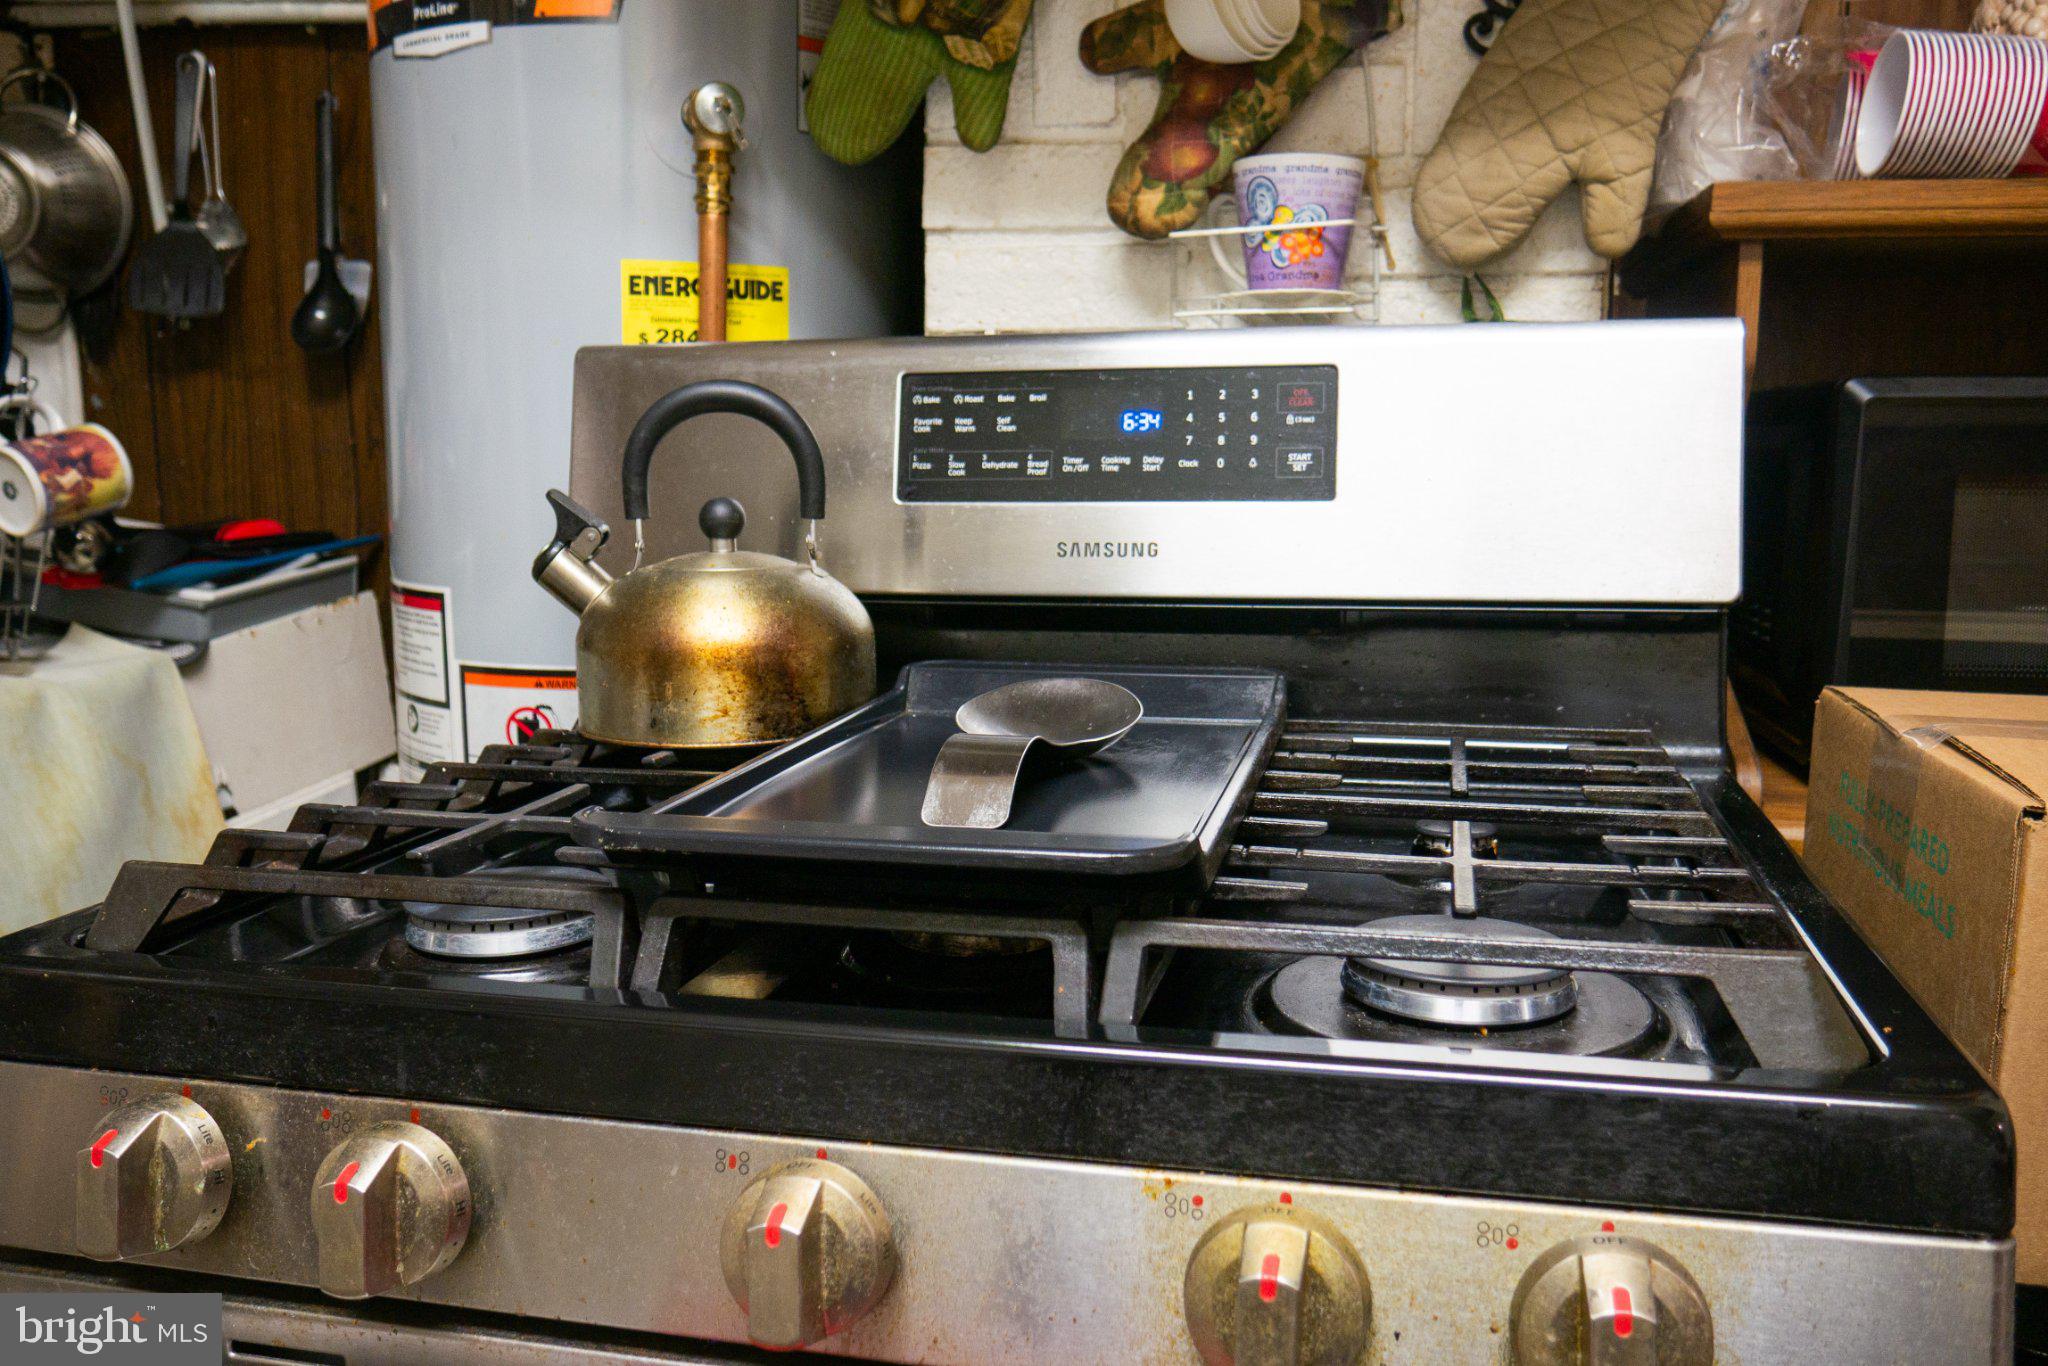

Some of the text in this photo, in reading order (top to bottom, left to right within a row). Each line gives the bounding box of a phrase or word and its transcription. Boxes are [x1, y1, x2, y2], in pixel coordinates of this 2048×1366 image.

[964, 394, 984, 404] Roast
[997, 394, 1016, 403] Bake
[1029, 393, 1047, 403] Broil
[1187, 390, 1194, 400] 1
[1218, 389, 1226, 400] 2
[1251, 388, 1259, 400] 3
[914, 417, 943, 426] Favorite
[955, 417, 973, 426] Keep
[997, 416, 1012, 425] Self
[1122, 412, 1162, 431] 6:34
[1186, 412, 1193, 423] 4
[1218, 412, 1226, 423] 5
[1250, 412, 1259, 423] 6
[913, 425, 931, 433] Cook
[955, 425, 976, 433] Warm
[997, 424, 1017, 432] Clean
[1186, 435, 1193, 446] 7
[1217, 435, 1225, 446] 8
[1250, 435, 1258, 446] 9
[1062, 456, 1084, 464] Timer
[1101, 456, 1131, 465] Cooking
[1142, 455, 1164, 465] Delay
[1287, 452, 1312, 462] START
[912, 462, 931, 470] Pizza
[948, 461, 966, 469] Slow
[982, 460, 1019, 470] Dehydrate
[1027, 460, 1049, 468] Bread
[1101, 464, 1120, 472] Time
[1142, 464, 1161, 472] Start
[1178, 458, 1199, 468] Clock
[1217, 458, 1224, 468] 0
[1292, 464, 1307, 472] SET
[948, 468, 966, 476] Cook
[1027, 468, 1047, 476] Proof
[1056, 542, 1158, 558] SAMSUNG
[197, 1124, 214, 1145] Lite
[437, 1154, 453, 1175] Lite
